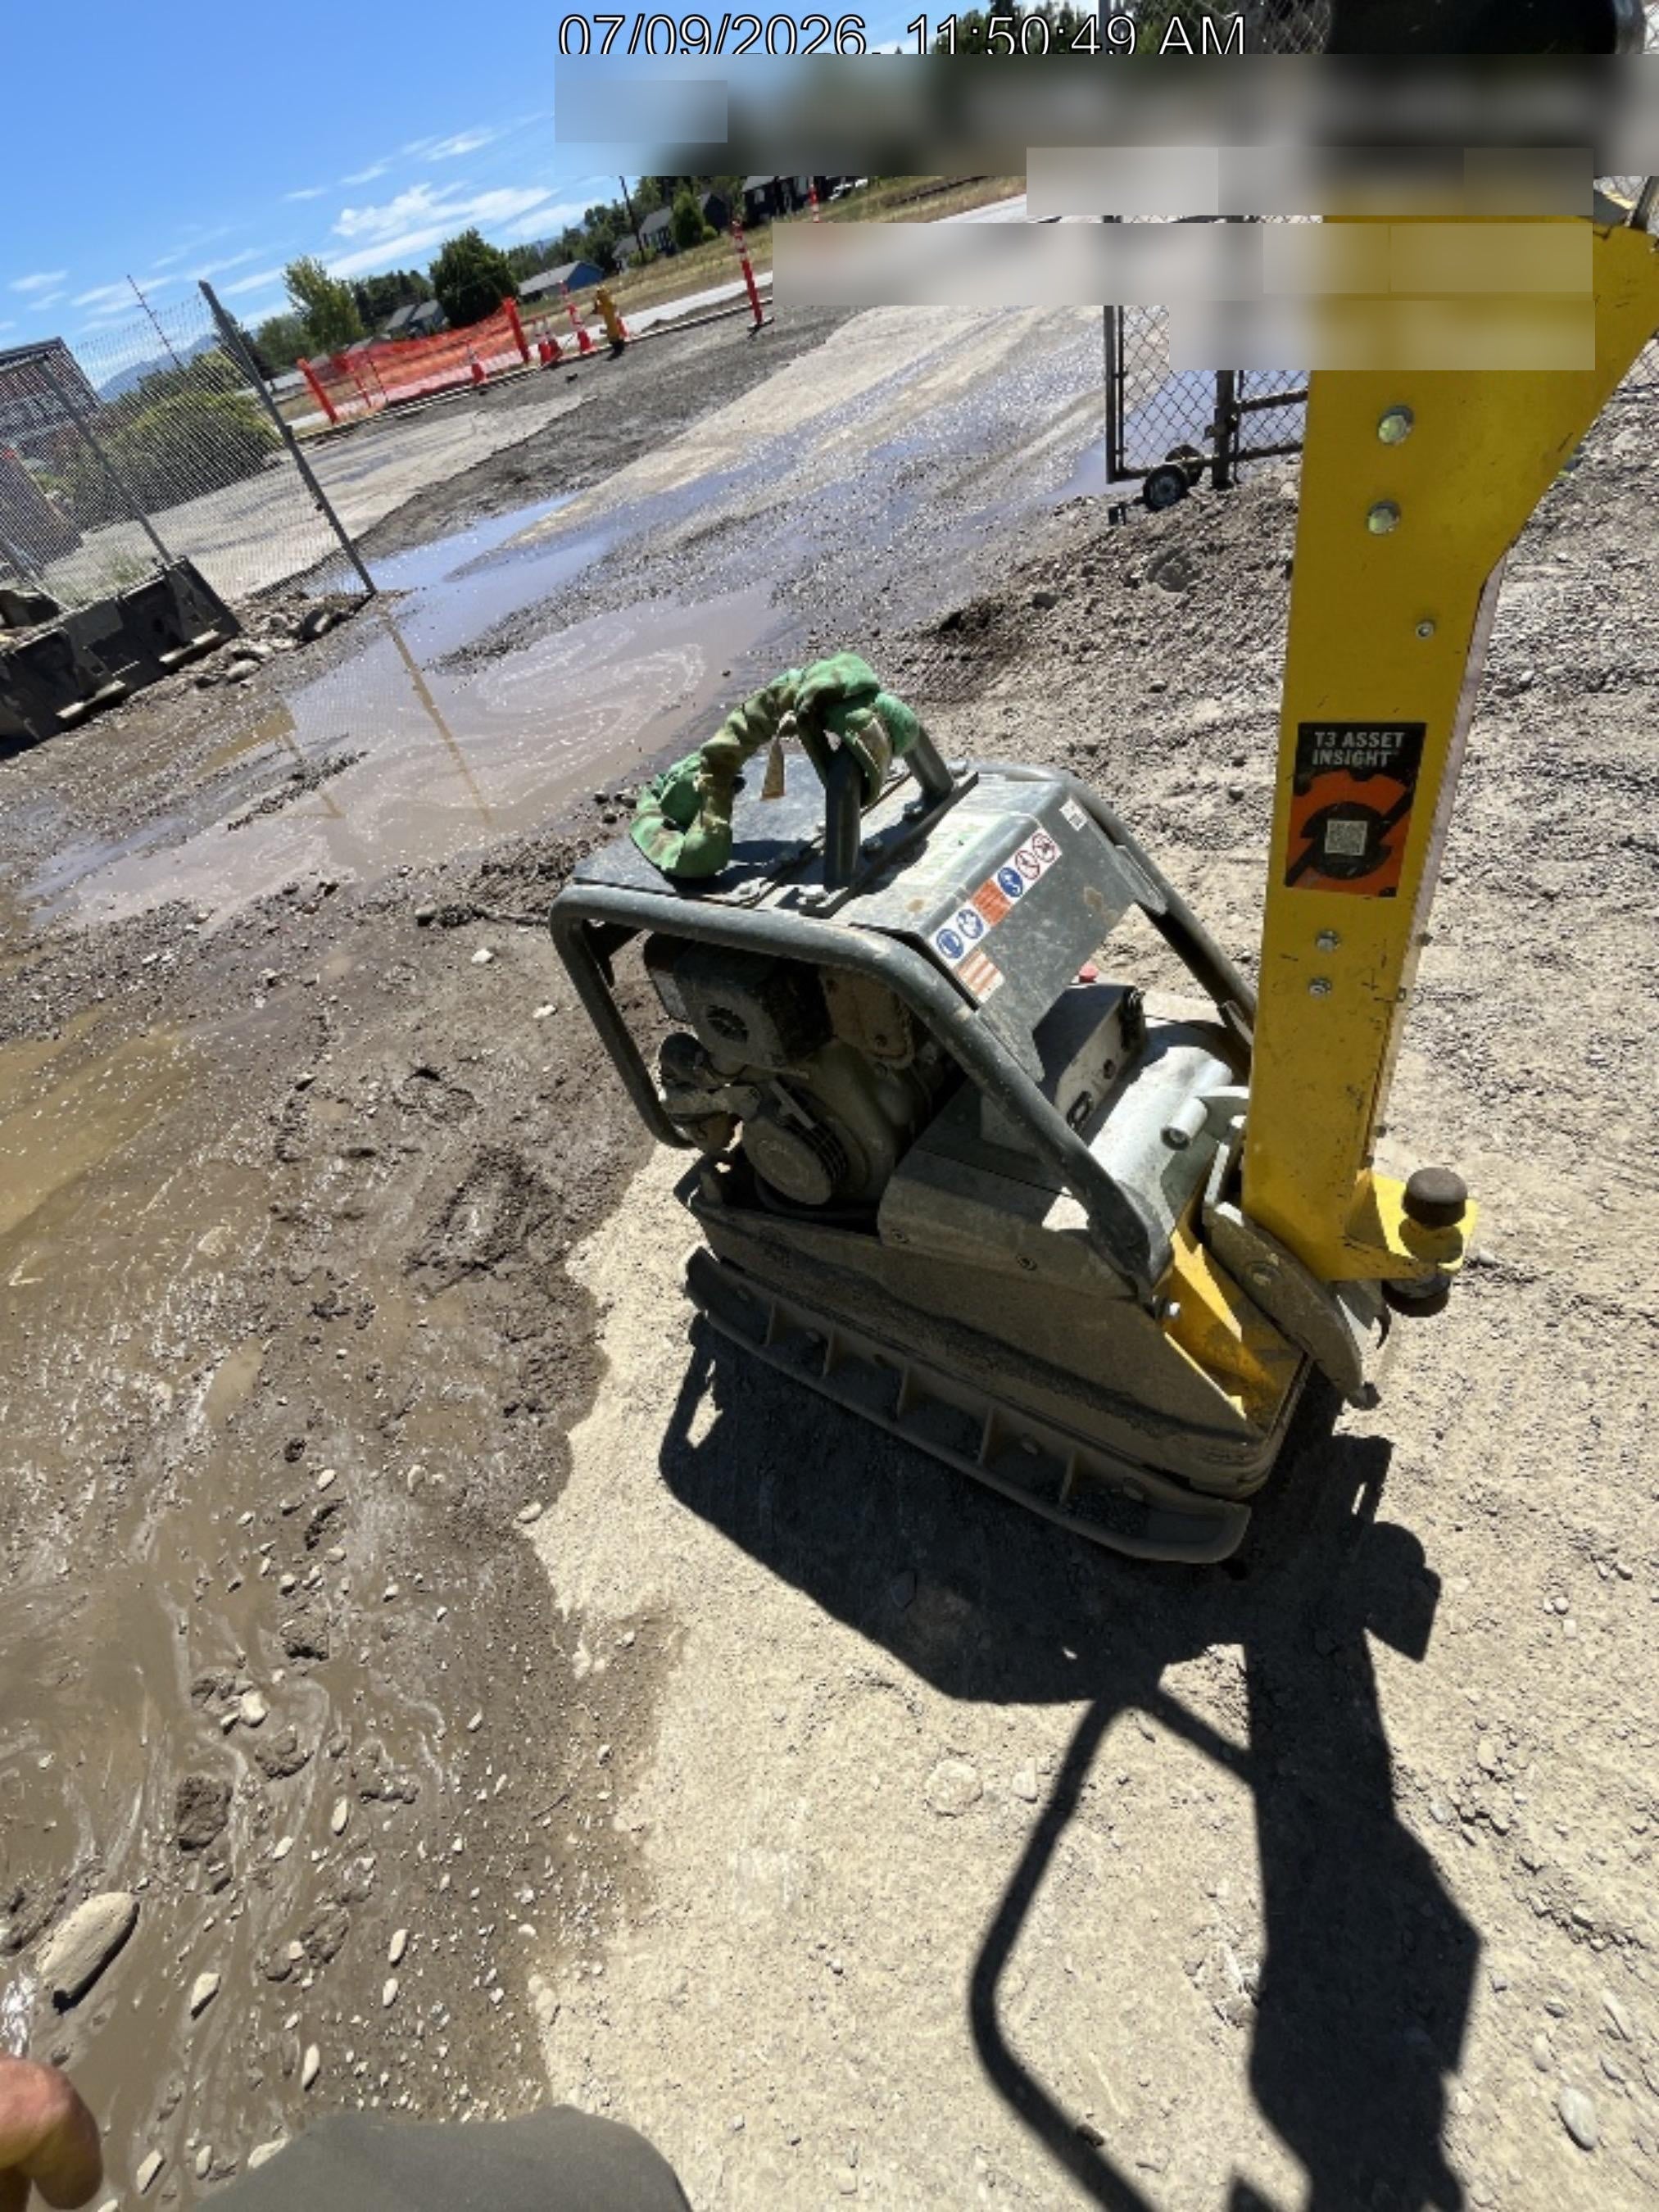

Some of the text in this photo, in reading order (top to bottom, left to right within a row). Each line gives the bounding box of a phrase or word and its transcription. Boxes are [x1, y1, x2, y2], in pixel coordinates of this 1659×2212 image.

[1314, 731, 1405, 749] T3 ASSET
[1312, 749, 1392, 768] INSIGHT
